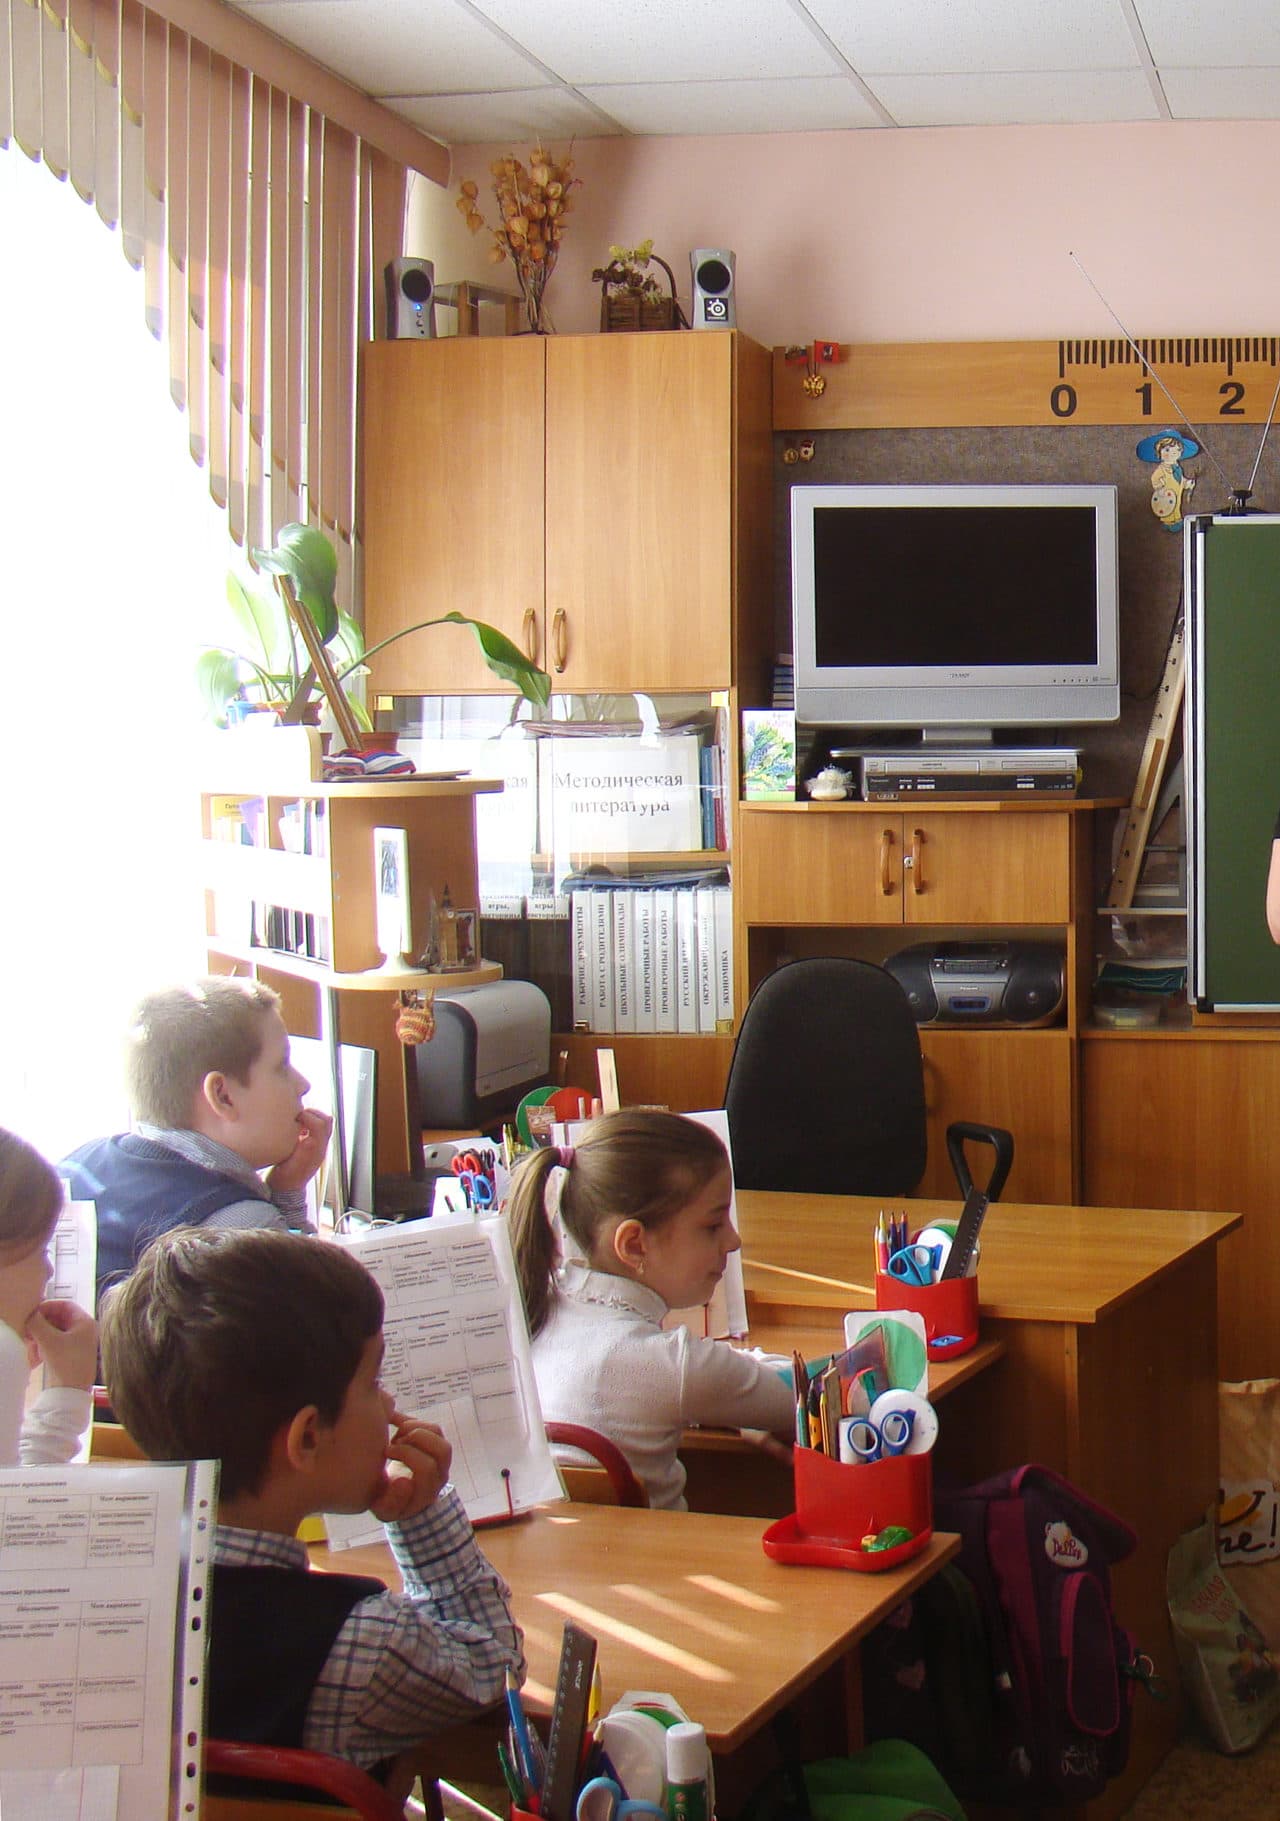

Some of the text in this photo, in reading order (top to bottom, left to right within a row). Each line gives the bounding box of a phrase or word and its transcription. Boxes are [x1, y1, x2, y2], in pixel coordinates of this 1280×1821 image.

[1050, 384, 1077, 417] 0
[1135, 382, 1152, 415] 1
[1219, 382, 1246, 415] 2
[554, 773, 683, 789] Методическая
